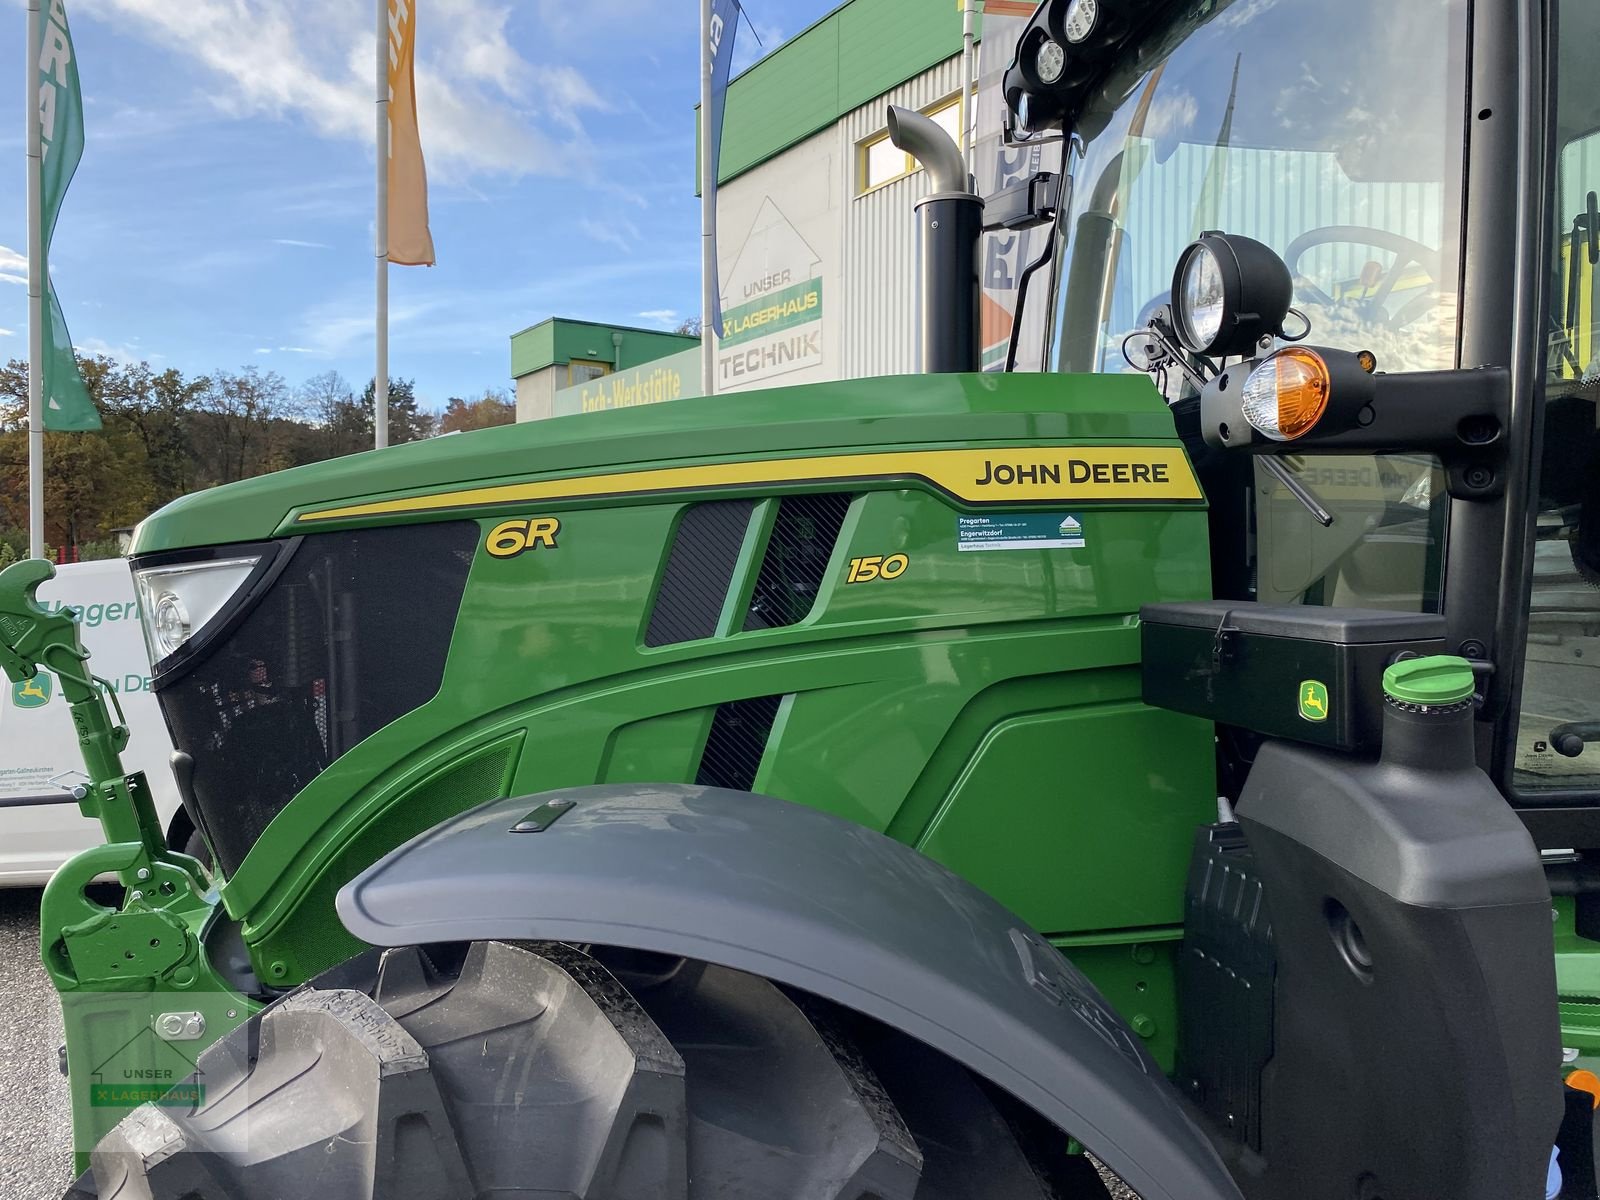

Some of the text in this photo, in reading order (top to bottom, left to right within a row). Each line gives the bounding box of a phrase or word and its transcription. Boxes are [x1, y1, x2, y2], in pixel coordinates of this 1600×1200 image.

[743, 269, 791, 298] UNSER
[734, 291, 818, 334] LAGERHAUS
[720, 330, 820, 379] TECHNIK
[975, 459, 1169, 486] JOHN DEERE
[959, 517, 989, 525] Pregarten
[485, 517, 562, 559] 6R
[846, 552, 910, 584] 150
